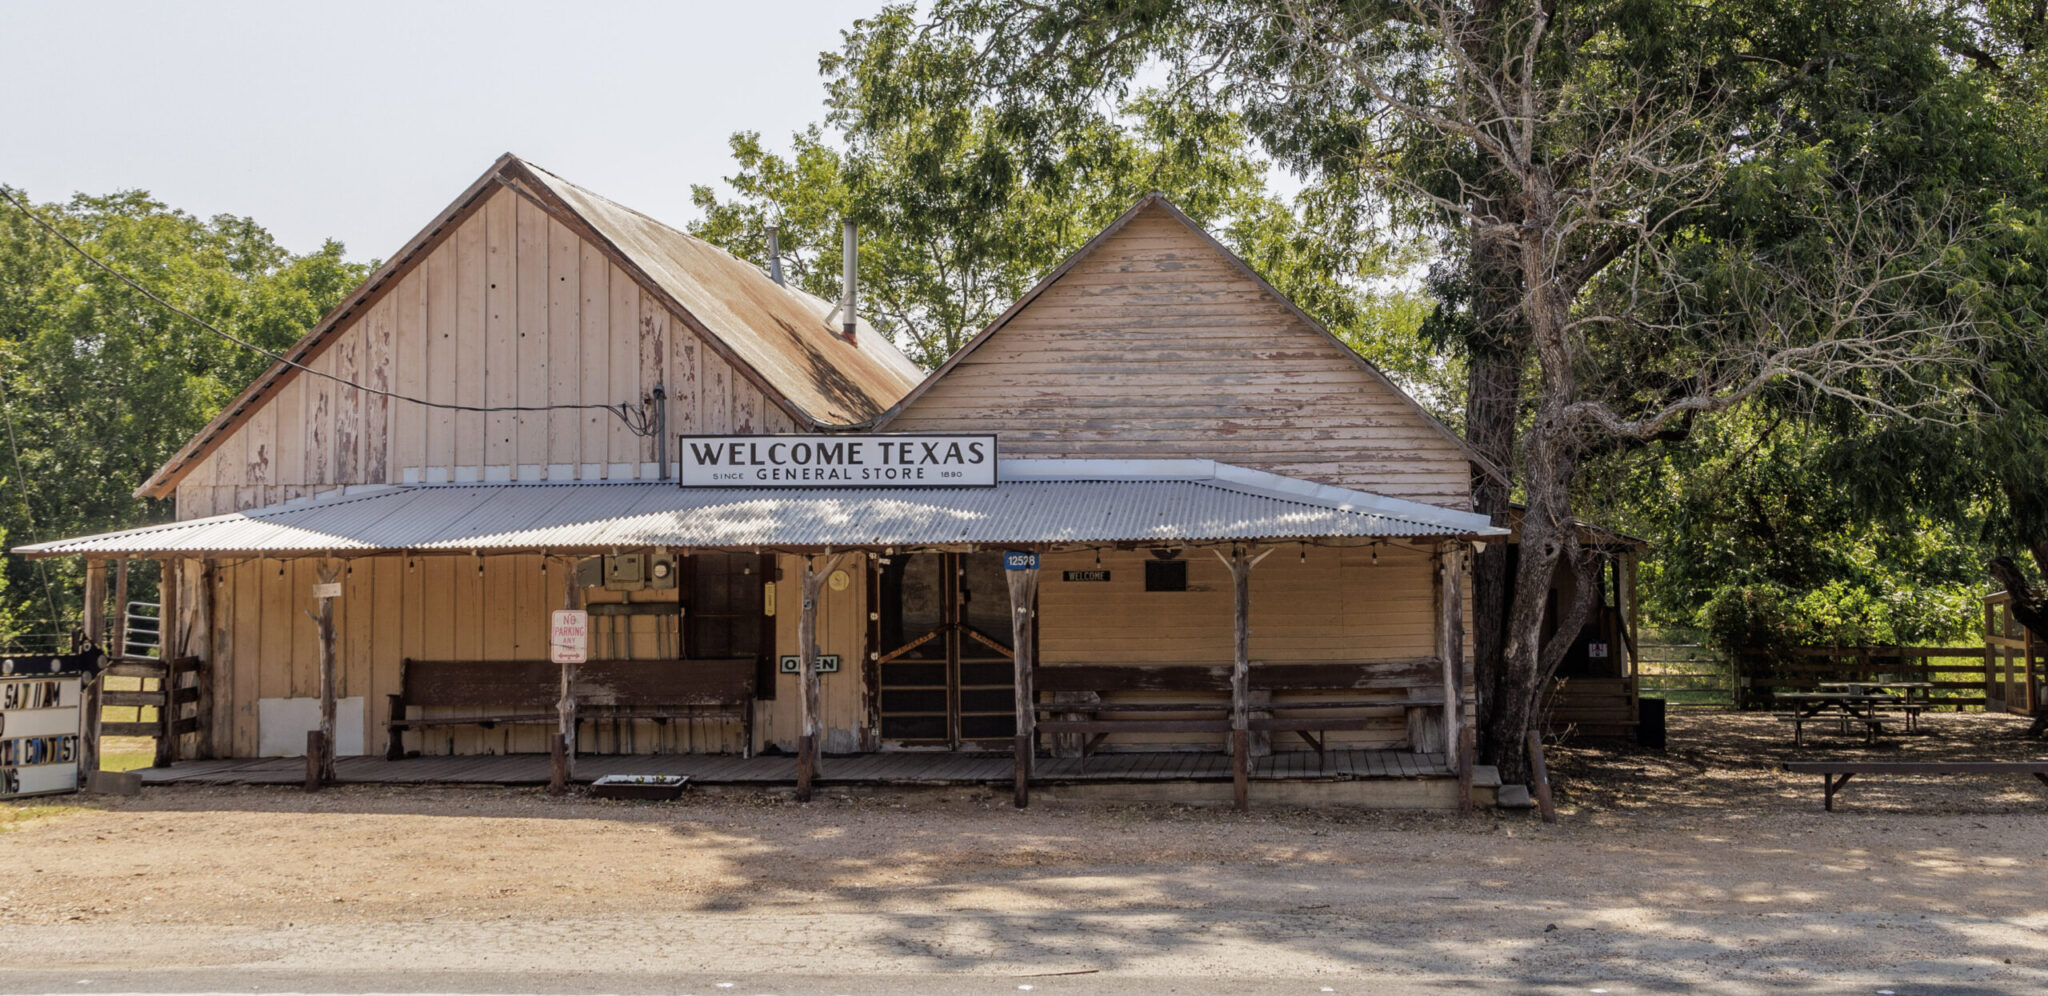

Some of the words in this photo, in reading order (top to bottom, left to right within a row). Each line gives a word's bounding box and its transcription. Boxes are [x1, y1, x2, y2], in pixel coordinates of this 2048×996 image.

[690, 442, 864, 466] WELCOME
[877, 441, 985, 465] TEXAS
[712, 472, 744, 480] SINCE
[756, 467, 853, 481] GENERAL
[862, 467, 925, 480] STORE
[1068, 571, 1105, 581] WELCOME
[563, 615, 577, 625] NO
[554, 626, 585, 637] PARKING
[784, 659, 835, 670] OEN
[4, 683, 31, 709] SAT
[25, 736, 78, 764] CONTEST
